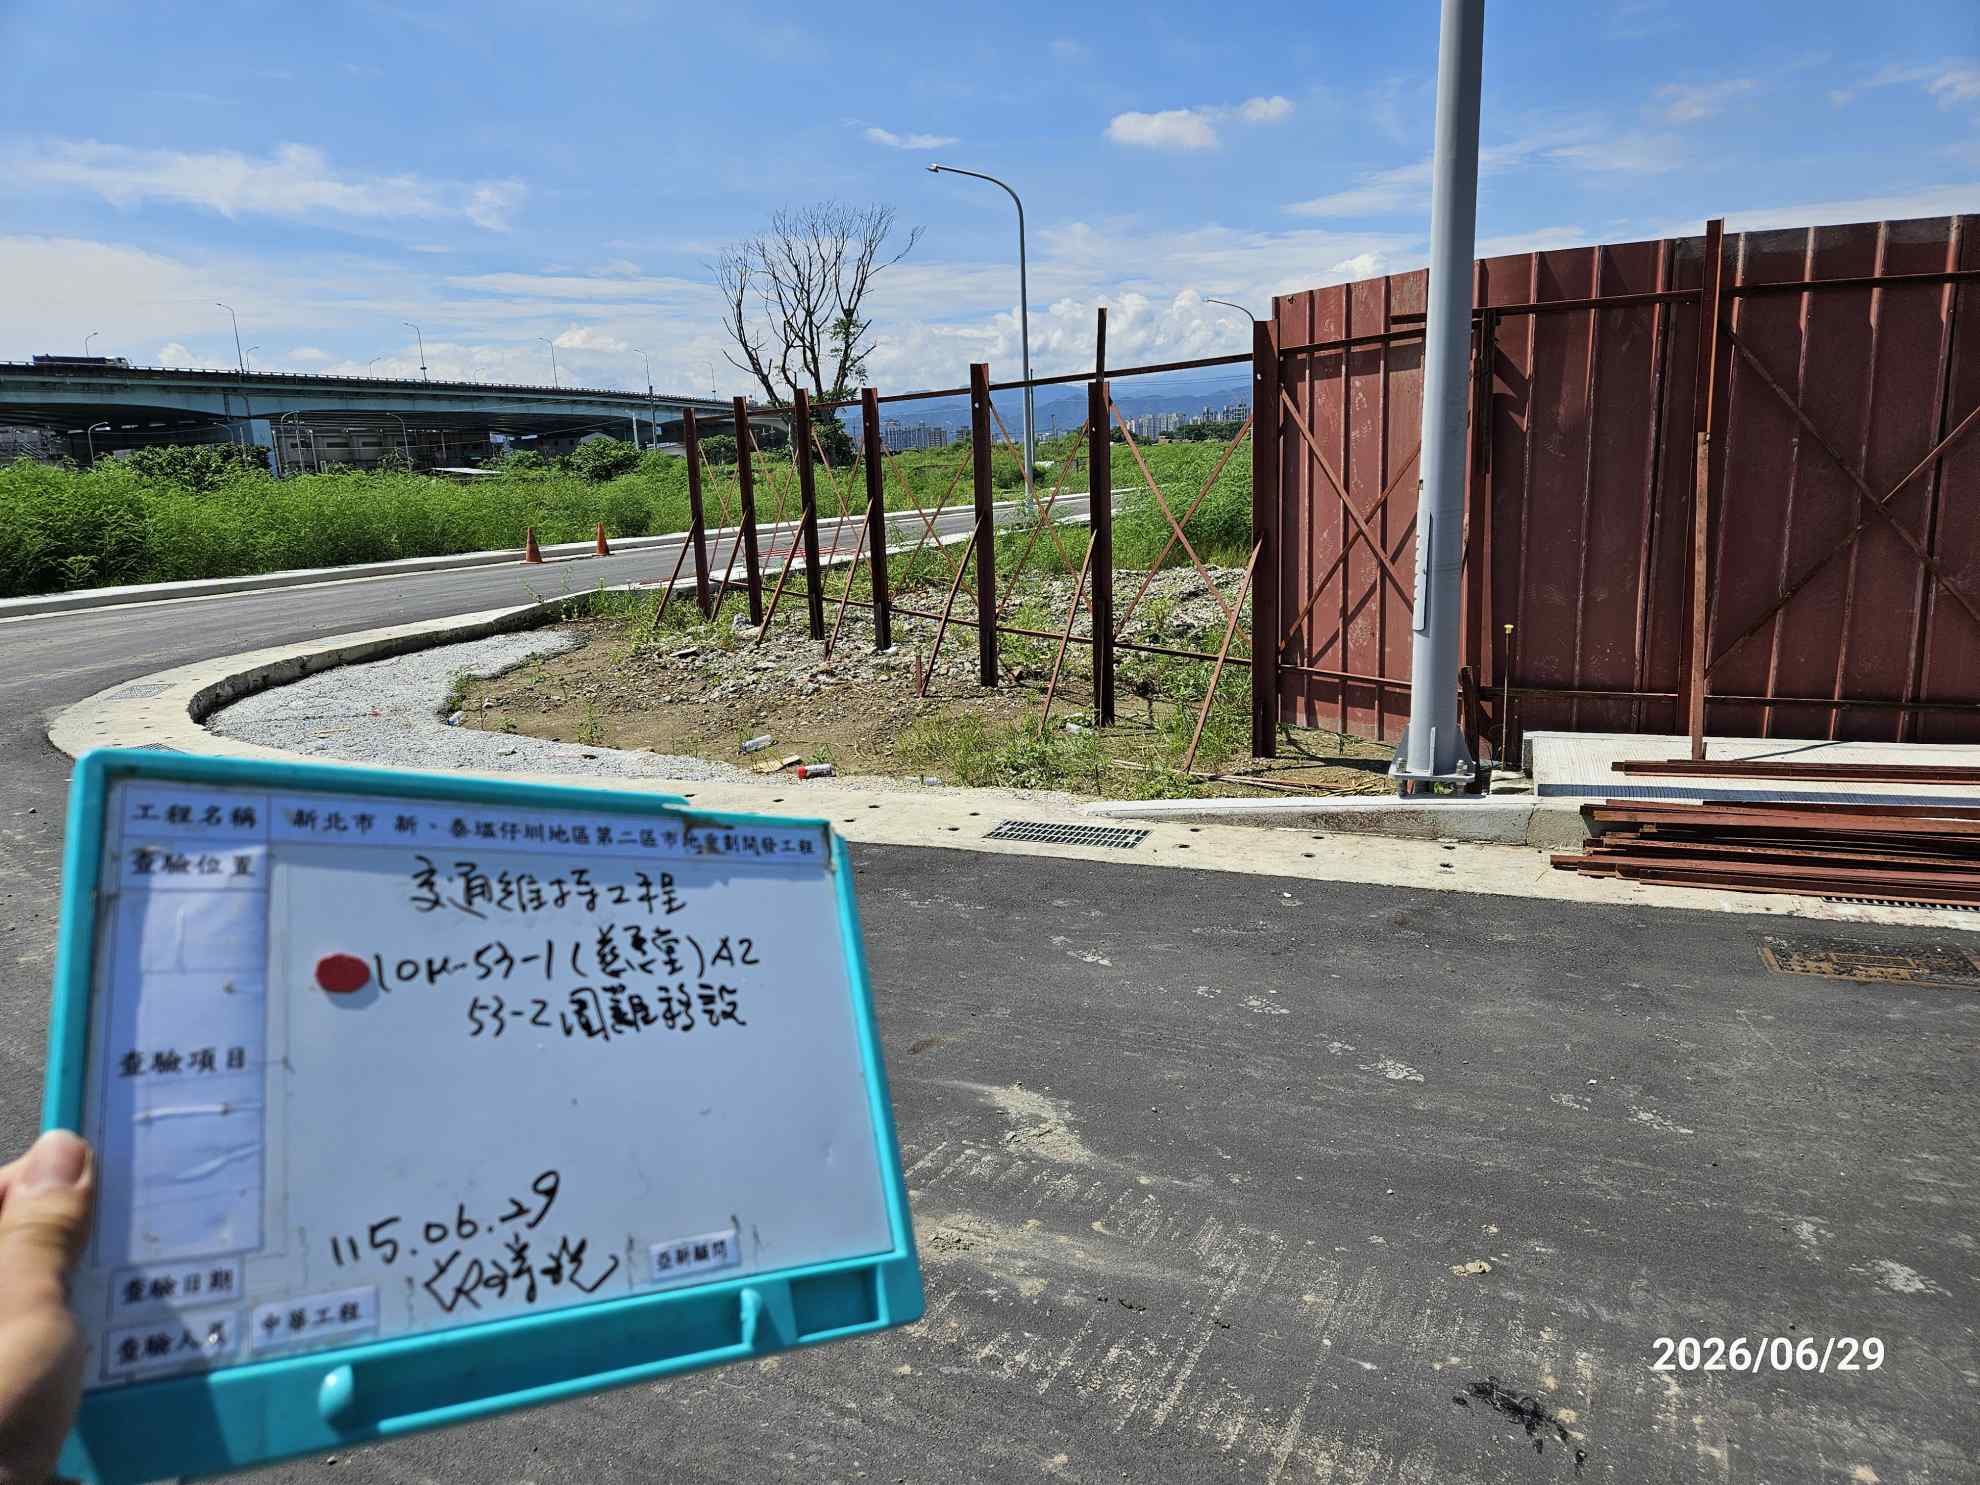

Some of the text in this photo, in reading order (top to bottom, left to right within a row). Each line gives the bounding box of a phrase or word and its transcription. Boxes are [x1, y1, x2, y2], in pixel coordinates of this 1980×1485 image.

[131, 802, 257, 829] 工程名稱
[130, 847, 257, 876] 查驗位置
[409, 854, 688, 920] 交通維持工程
[118, 1046, 246, 1077] 查驗項目
[330, 1170, 560, 1267] 115.06.29
[122, 1266, 233, 1305] 查驗日期
[260, 1301, 363, 1337] 中華工程
